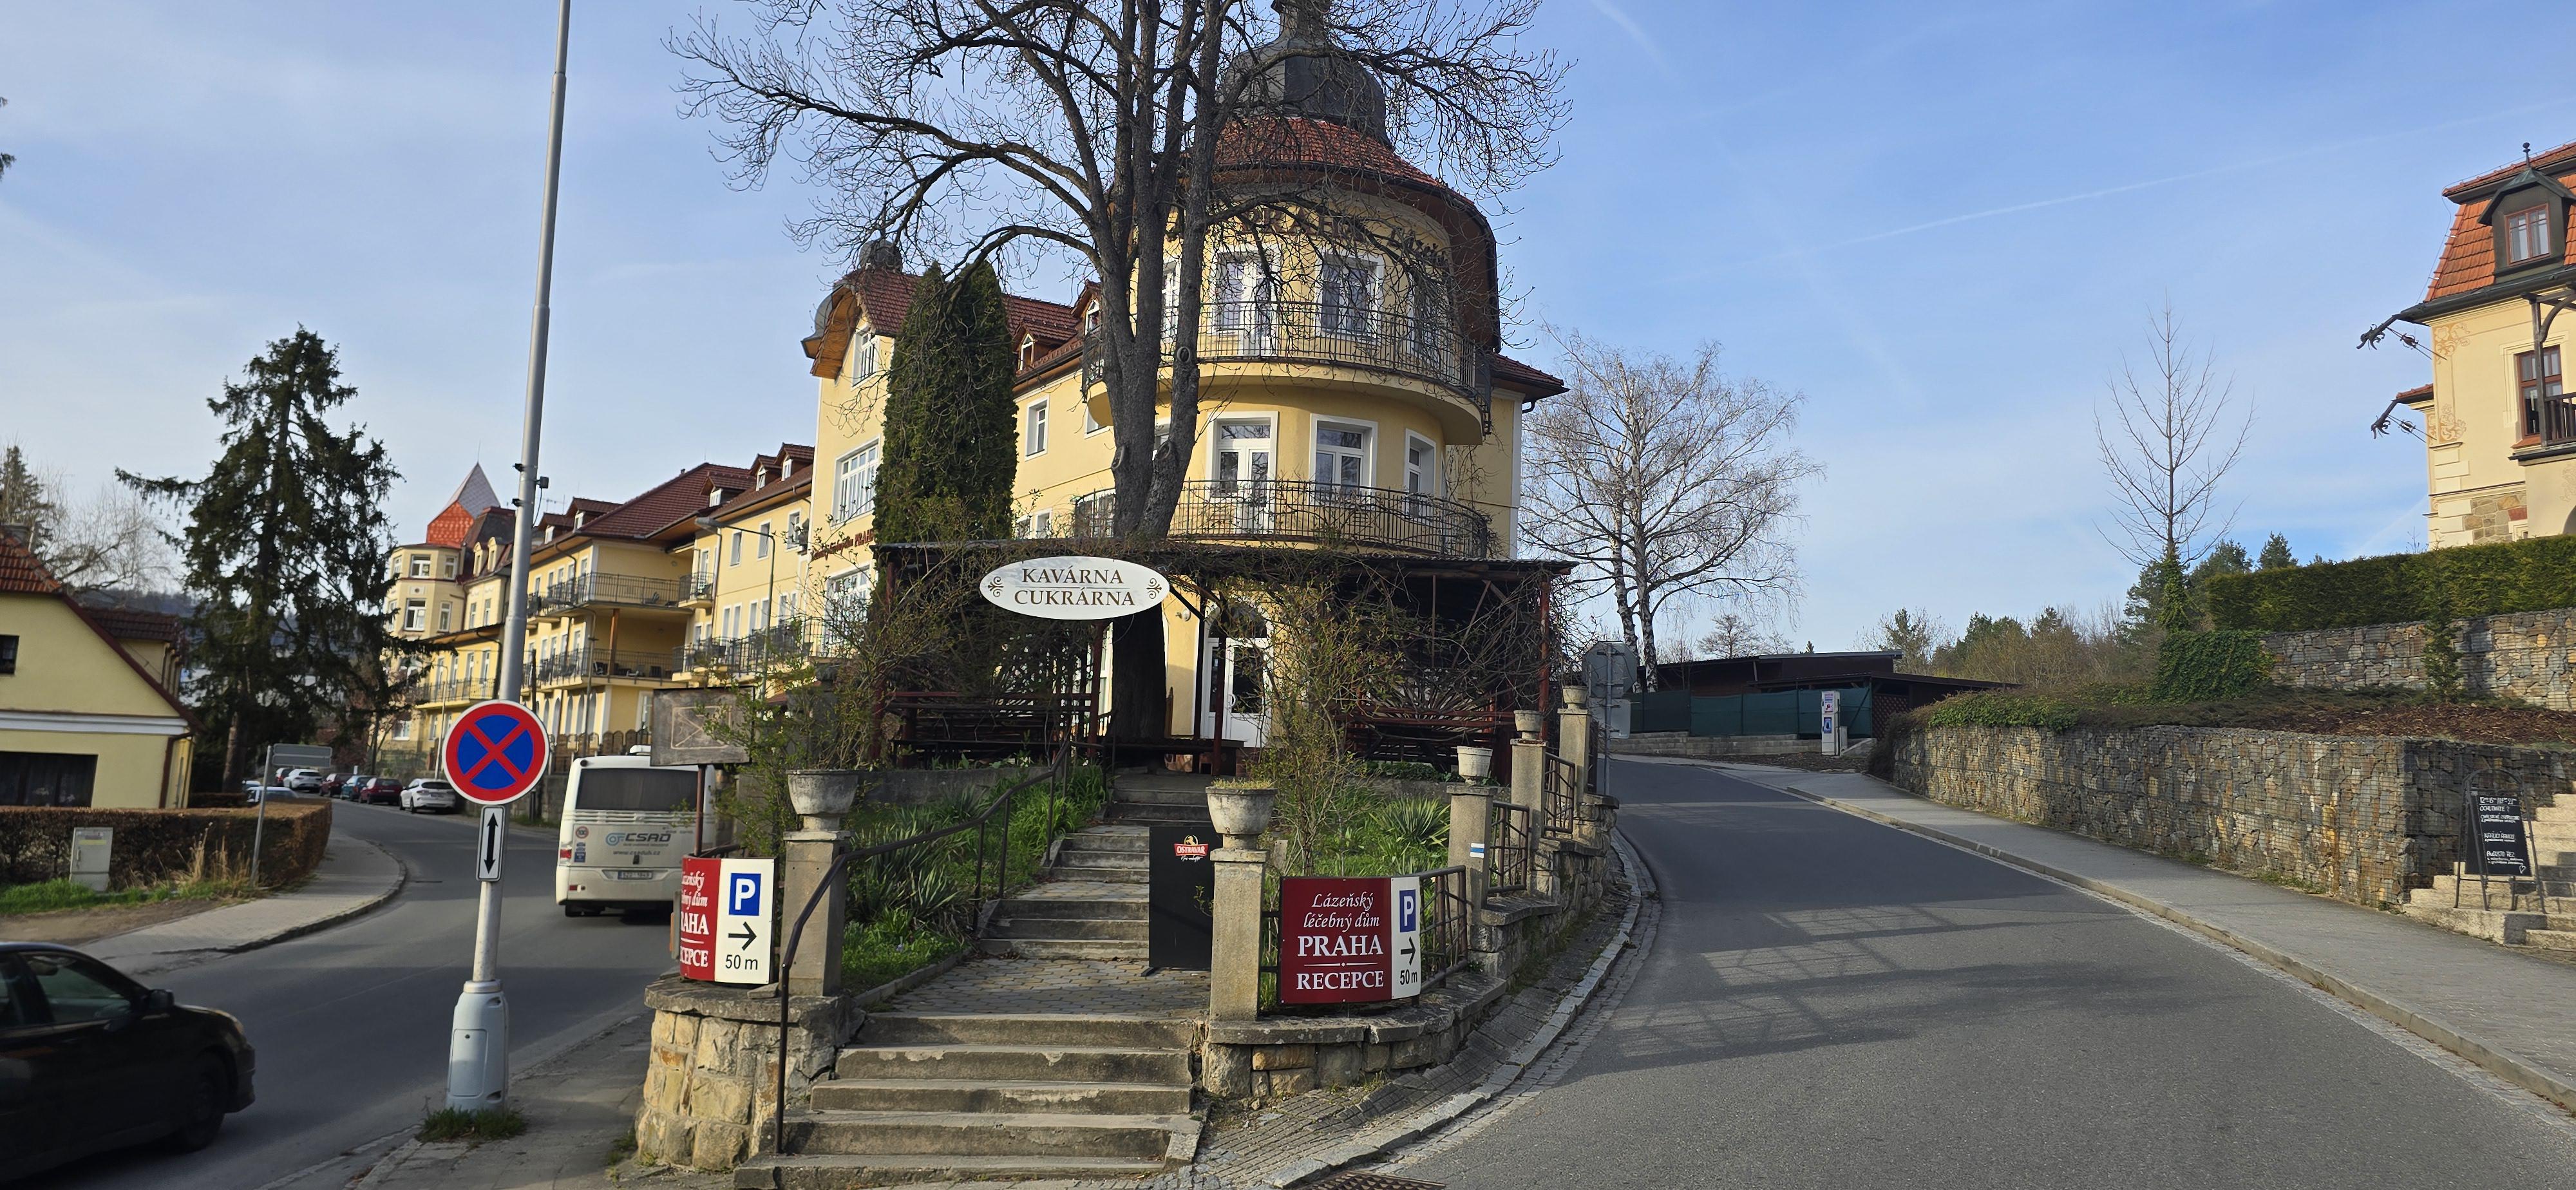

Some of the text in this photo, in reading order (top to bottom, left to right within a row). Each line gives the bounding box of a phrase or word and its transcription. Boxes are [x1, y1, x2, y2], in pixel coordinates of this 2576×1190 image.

[1021, 565, 1124, 584] KAVÁRNA
[1014, 587, 1135, 606] CUKRÁRNA
[1176, 845, 1206, 855] OSTRAVAR
[735, 878, 756, 911] P
[1312, 891, 1374, 911] Lázeňský
[1403, 896, 1414, 927] P
[1303, 912, 1379, 932] léčebný dům
[1297, 934, 1384, 957] PRAHA
[725, 954, 758, 970] 50 m
[1296, 970, 1384, 990] RECEPCE
[1399, 969, 1417, 985] 50 m
